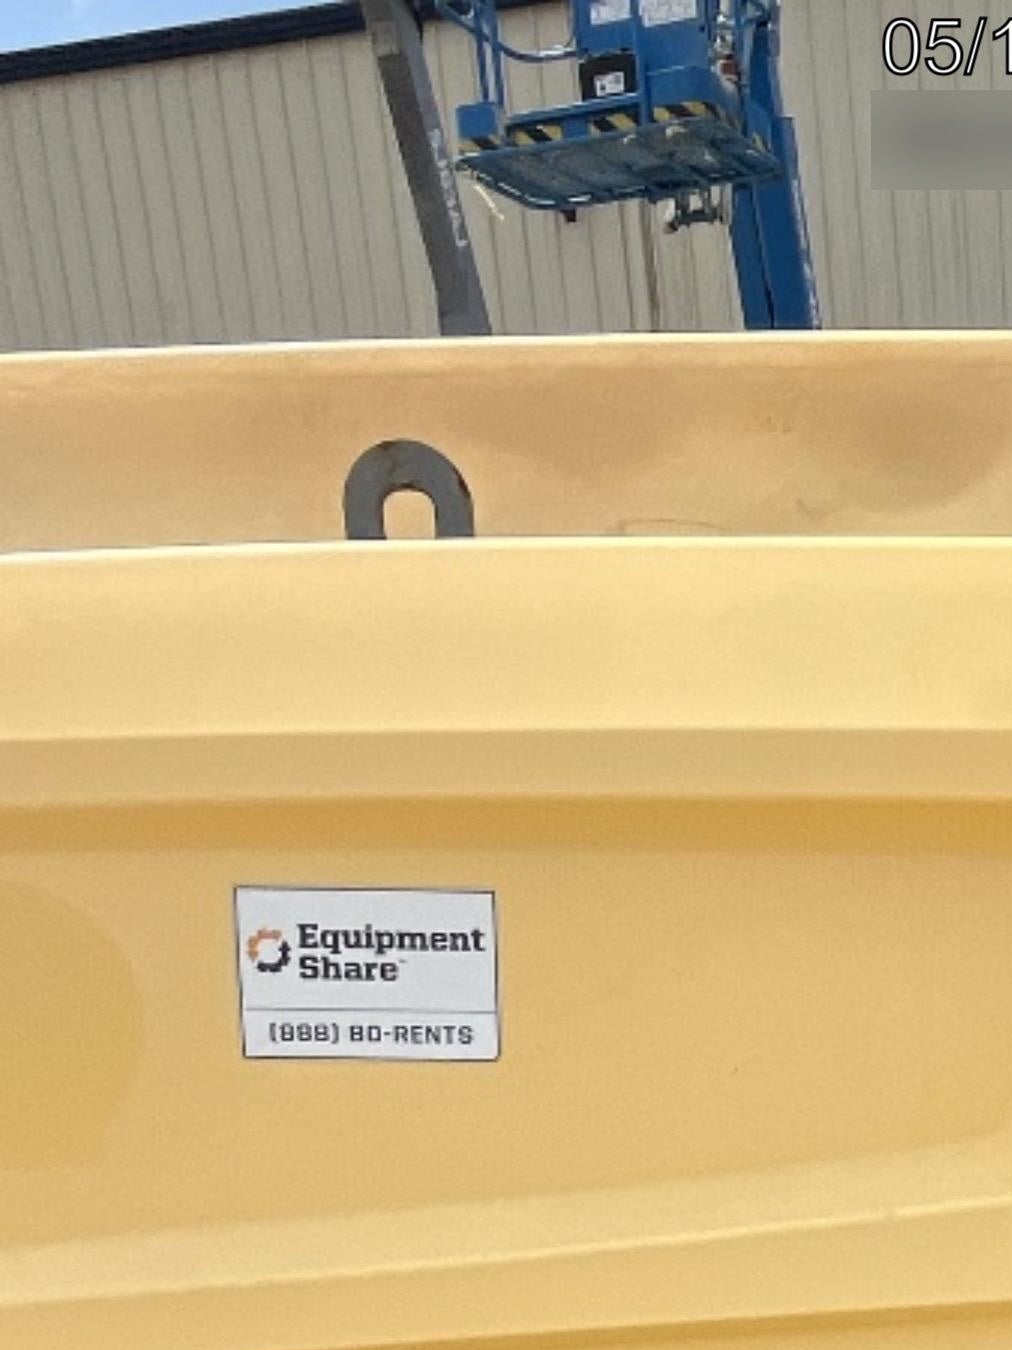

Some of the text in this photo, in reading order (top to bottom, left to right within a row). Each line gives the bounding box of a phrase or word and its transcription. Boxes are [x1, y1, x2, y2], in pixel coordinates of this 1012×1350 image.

[297, 923, 486, 954] Equipment
[299, 956, 398, 982] Share
[269, 1022, 340, 1045] (888)
